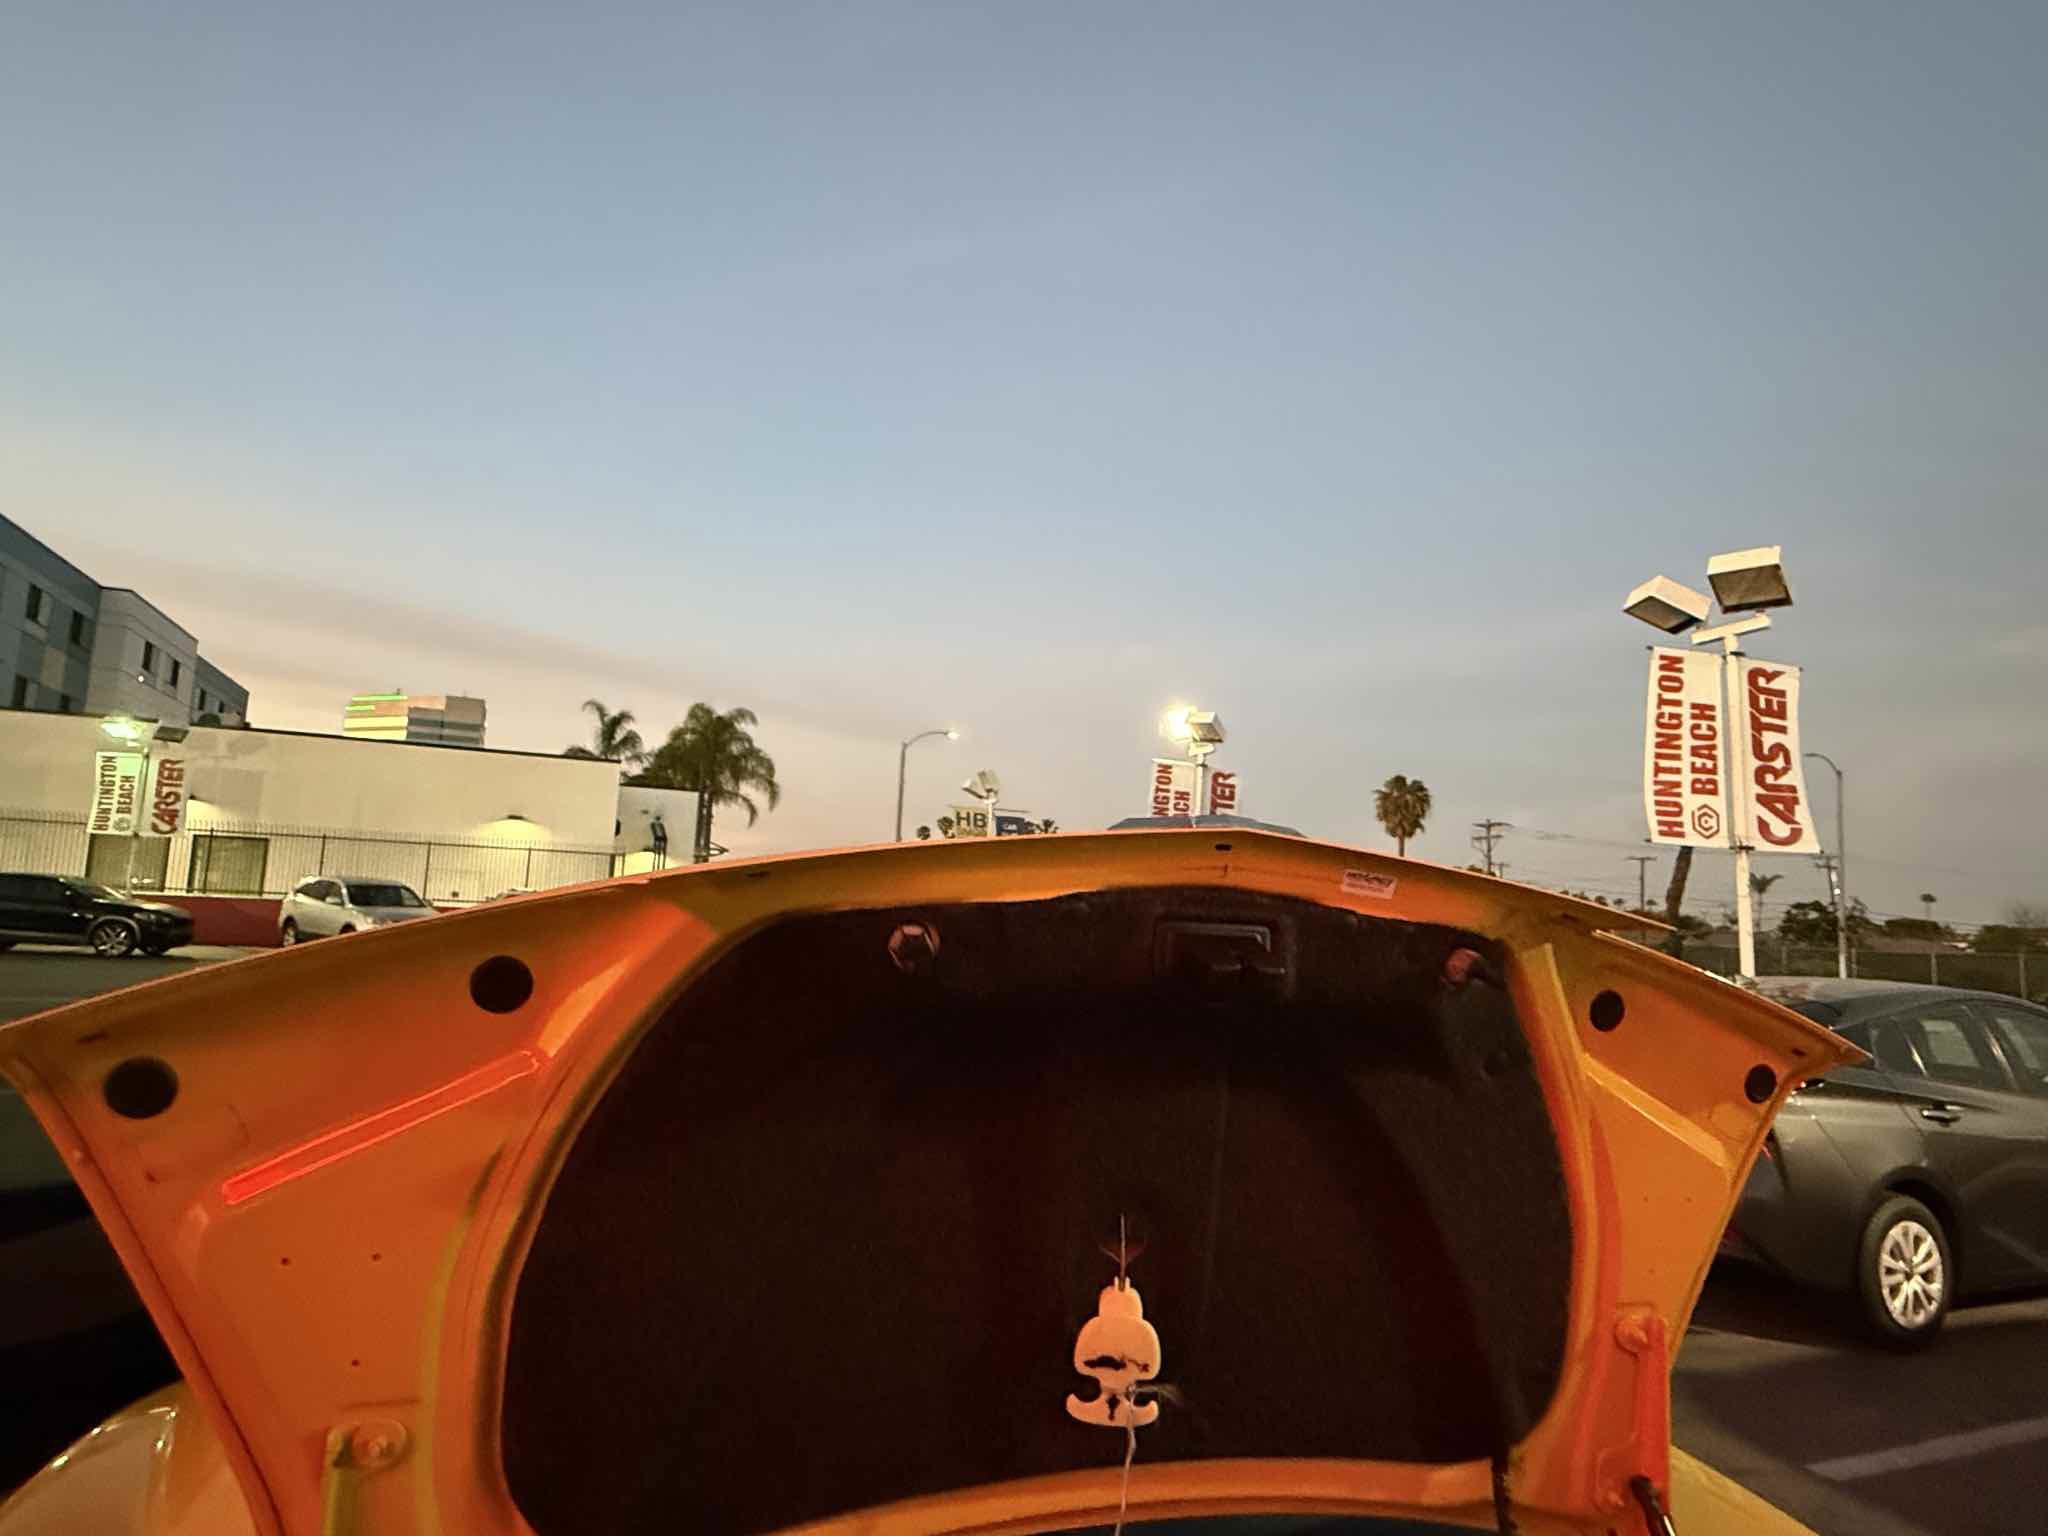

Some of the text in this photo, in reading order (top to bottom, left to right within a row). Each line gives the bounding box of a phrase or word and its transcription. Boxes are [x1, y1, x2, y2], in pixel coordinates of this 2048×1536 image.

[1653, 654, 1685, 838] HUNTINGTON
[1690, 702, 1719, 796] BEACH
[1747, 667, 1803, 846] CARSTER
[92, 756, 117, 831] HUNTINGTON
[116, 775, 135, 814] BEACH
[151, 758, 184, 833] CARSTER
[956, 811, 986, 828] HB
